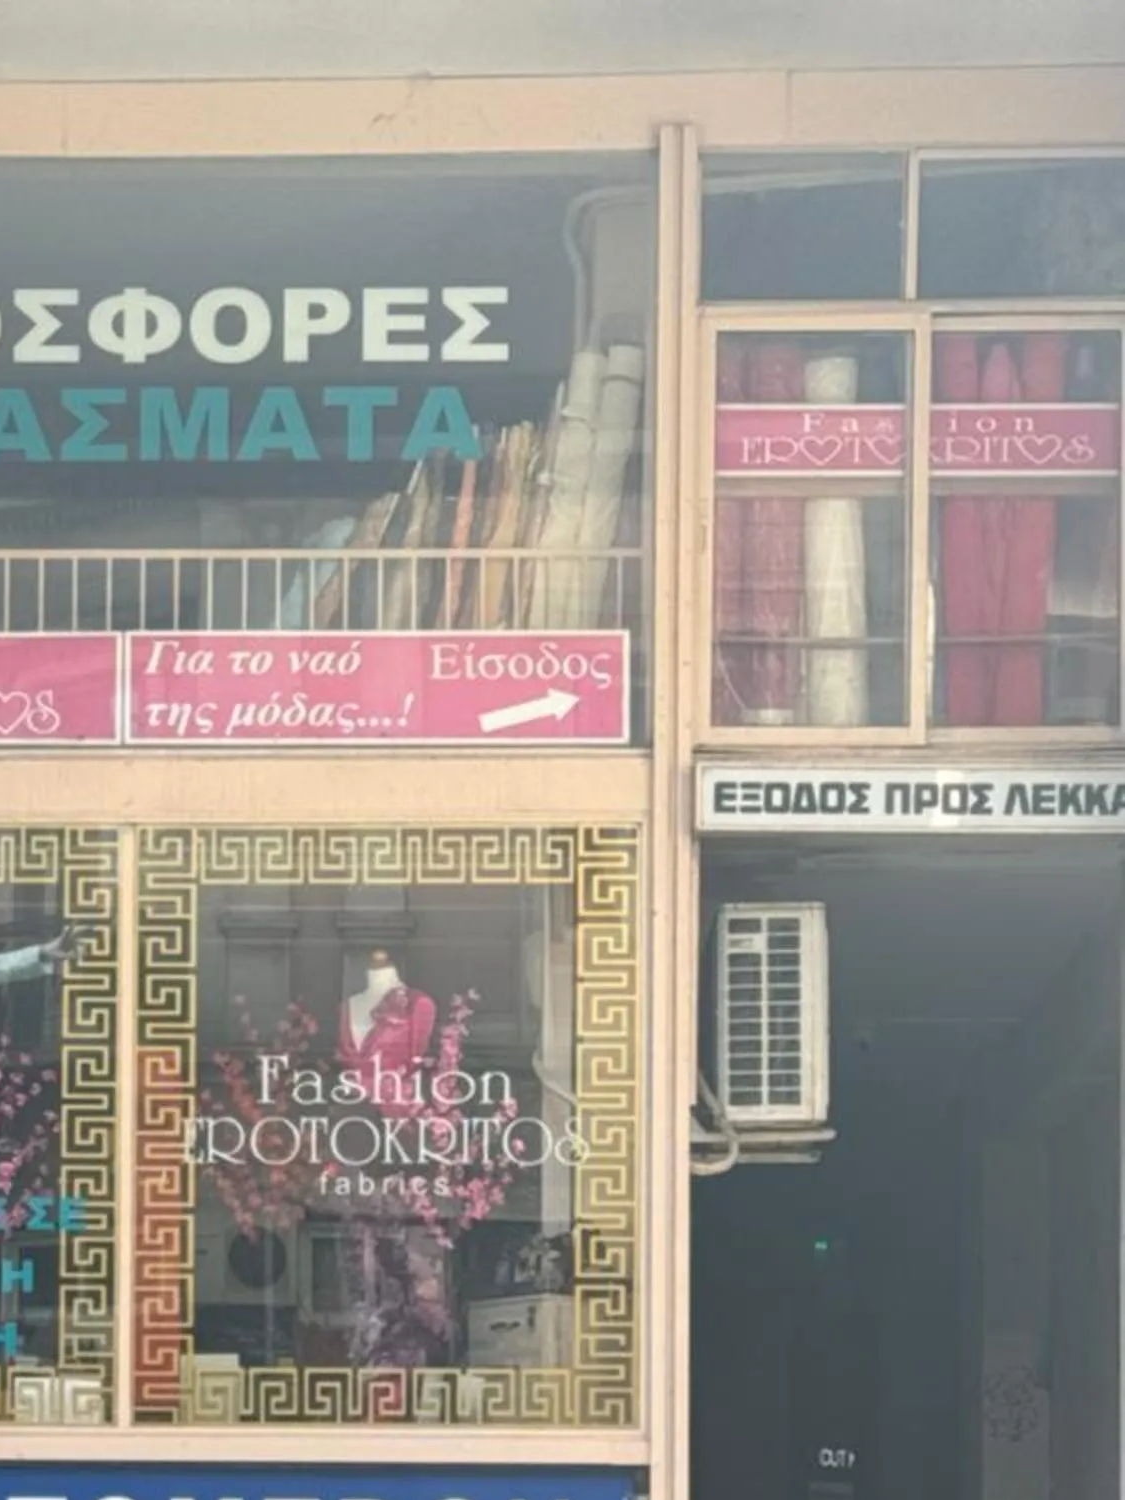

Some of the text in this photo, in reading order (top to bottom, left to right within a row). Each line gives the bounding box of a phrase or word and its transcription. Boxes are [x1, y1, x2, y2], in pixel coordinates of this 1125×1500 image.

[144, 640, 362, 676] Για το ναό
[429, 641, 613, 689] Είσοδος
[144, 699, 217, 735] της
[713, 781, 872, 815] ΕΞΟΔΟΣ
[884, 782, 995, 816] ΠΡΟΣ
[256, 1053, 513, 1106] Fashion
[182, 1116, 591, 1166] EROTOKRITOS
[320, 1172, 452, 1197] fabrics
[27, 1196, 89, 1232] ΣΕ
